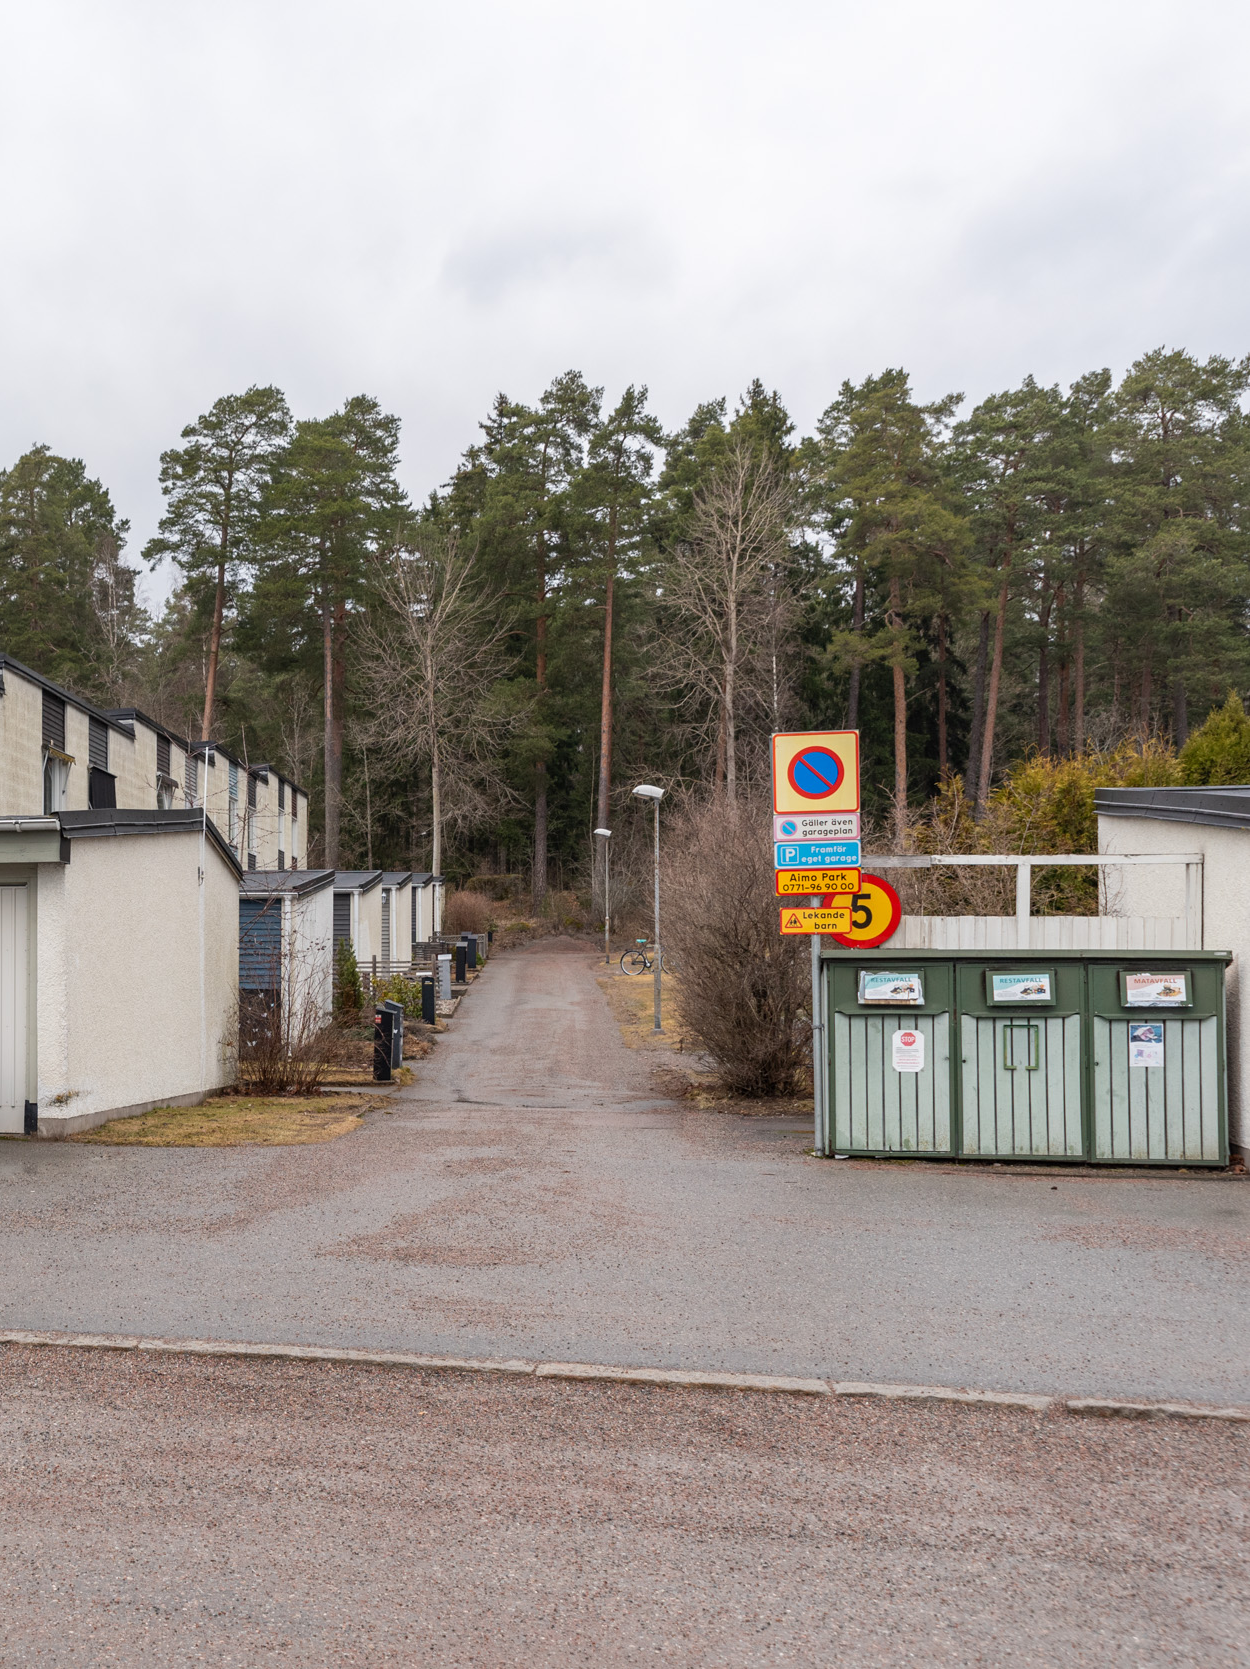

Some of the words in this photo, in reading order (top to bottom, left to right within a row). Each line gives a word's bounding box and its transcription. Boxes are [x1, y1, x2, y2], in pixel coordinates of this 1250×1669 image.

[801, 819, 828, 827] Gäller
[831, 818, 853, 826] även
[802, 827, 853, 837] garageplan
[810, 845, 847, 853] Framför
[785, 848, 796, 862] P
[801, 855, 822, 864] eget
[824, 855, 858, 864] garage
[789, 873, 817, 882] Aimo
[821, 872, 847, 881] Park
[782, 883, 822, 892] 0771-96
[824, 883, 838, 891] 90
[840, 882, 855, 891] 00
[802, 911, 845, 920] Lekande
[851, 893, 873, 929] 5
[814, 922, 838, 930] barn
